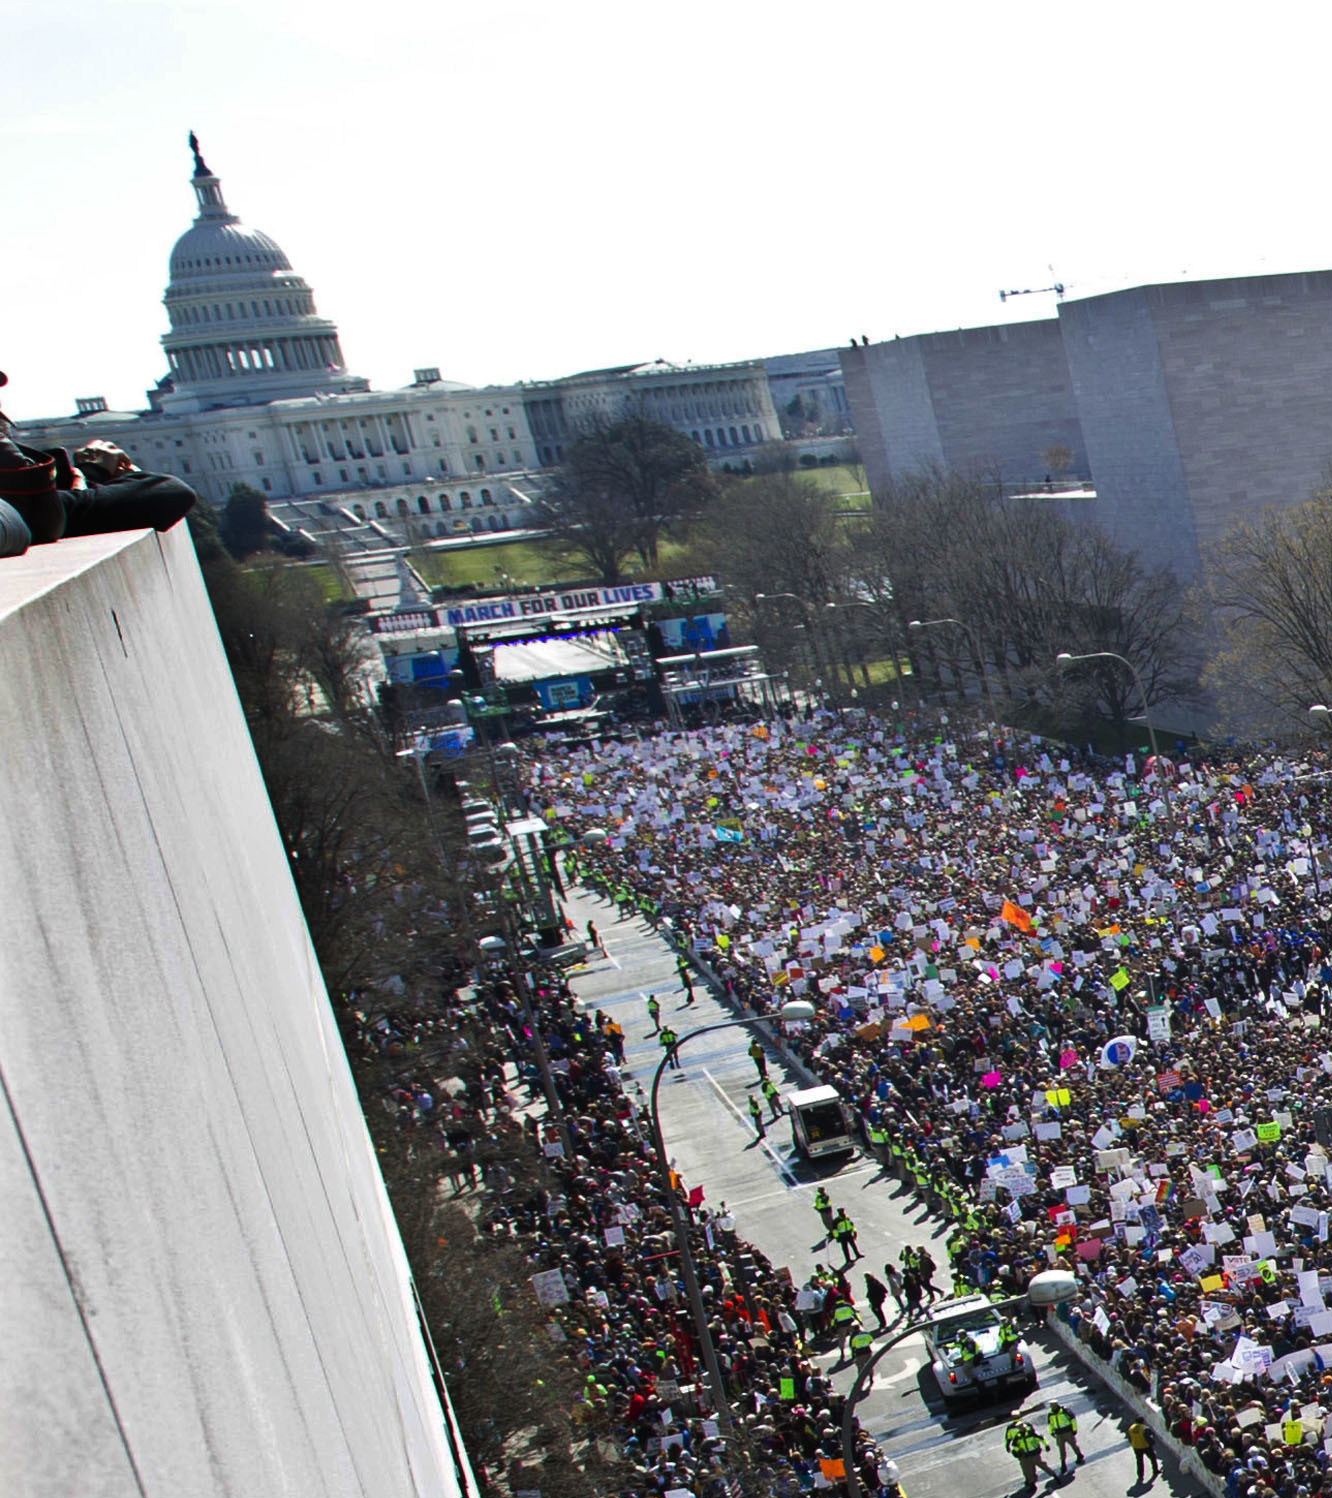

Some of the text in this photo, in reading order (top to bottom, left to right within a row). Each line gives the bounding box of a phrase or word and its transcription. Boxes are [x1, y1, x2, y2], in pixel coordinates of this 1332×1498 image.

[448, 584, 653, 625] MARCH FOR OUR LIVES
